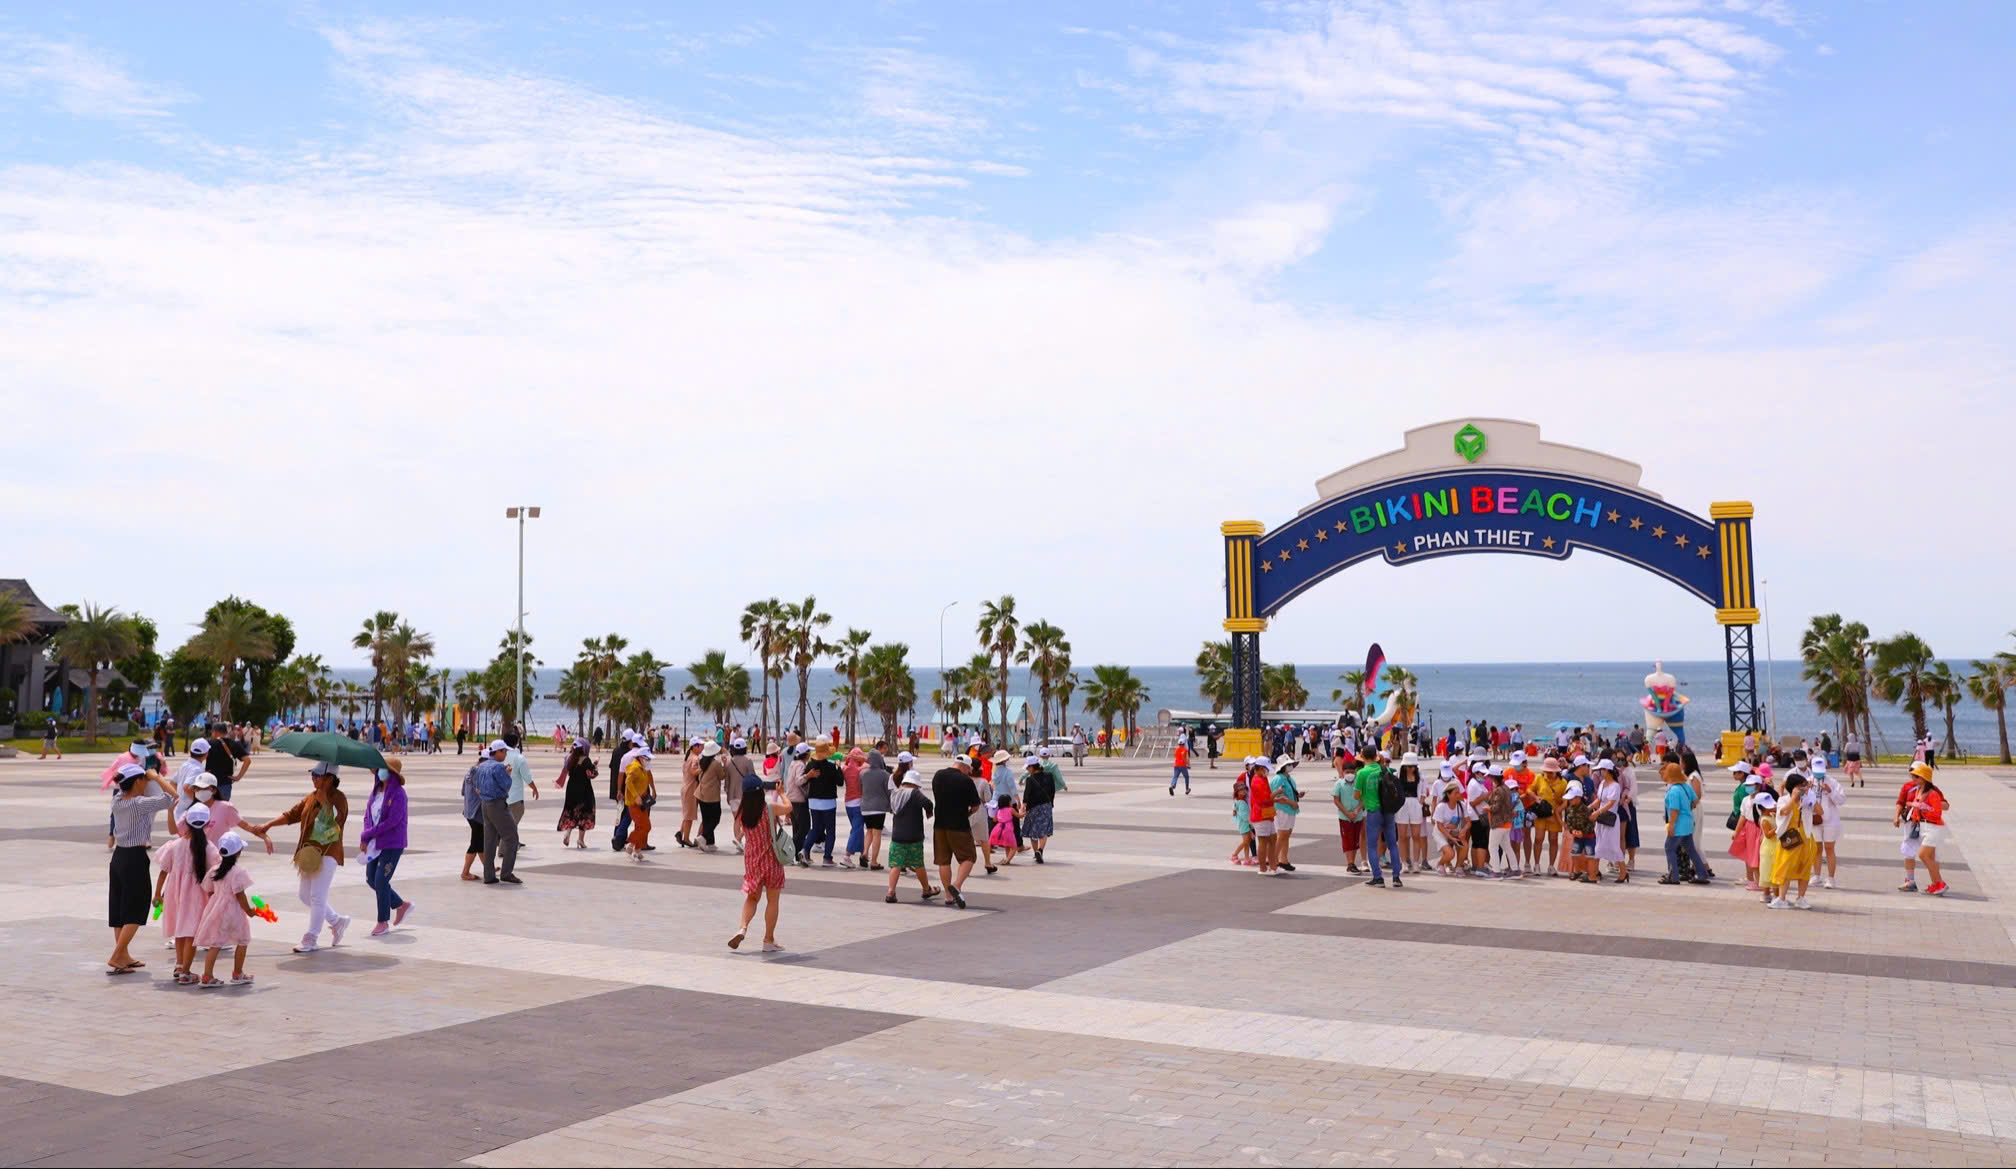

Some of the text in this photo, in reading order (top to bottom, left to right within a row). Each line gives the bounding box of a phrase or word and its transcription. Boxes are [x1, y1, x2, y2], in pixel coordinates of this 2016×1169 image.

[1350, 486, 1602, 534] BIKINI BEACH
[1413, 529, 1535, 551] PHAN THIET
